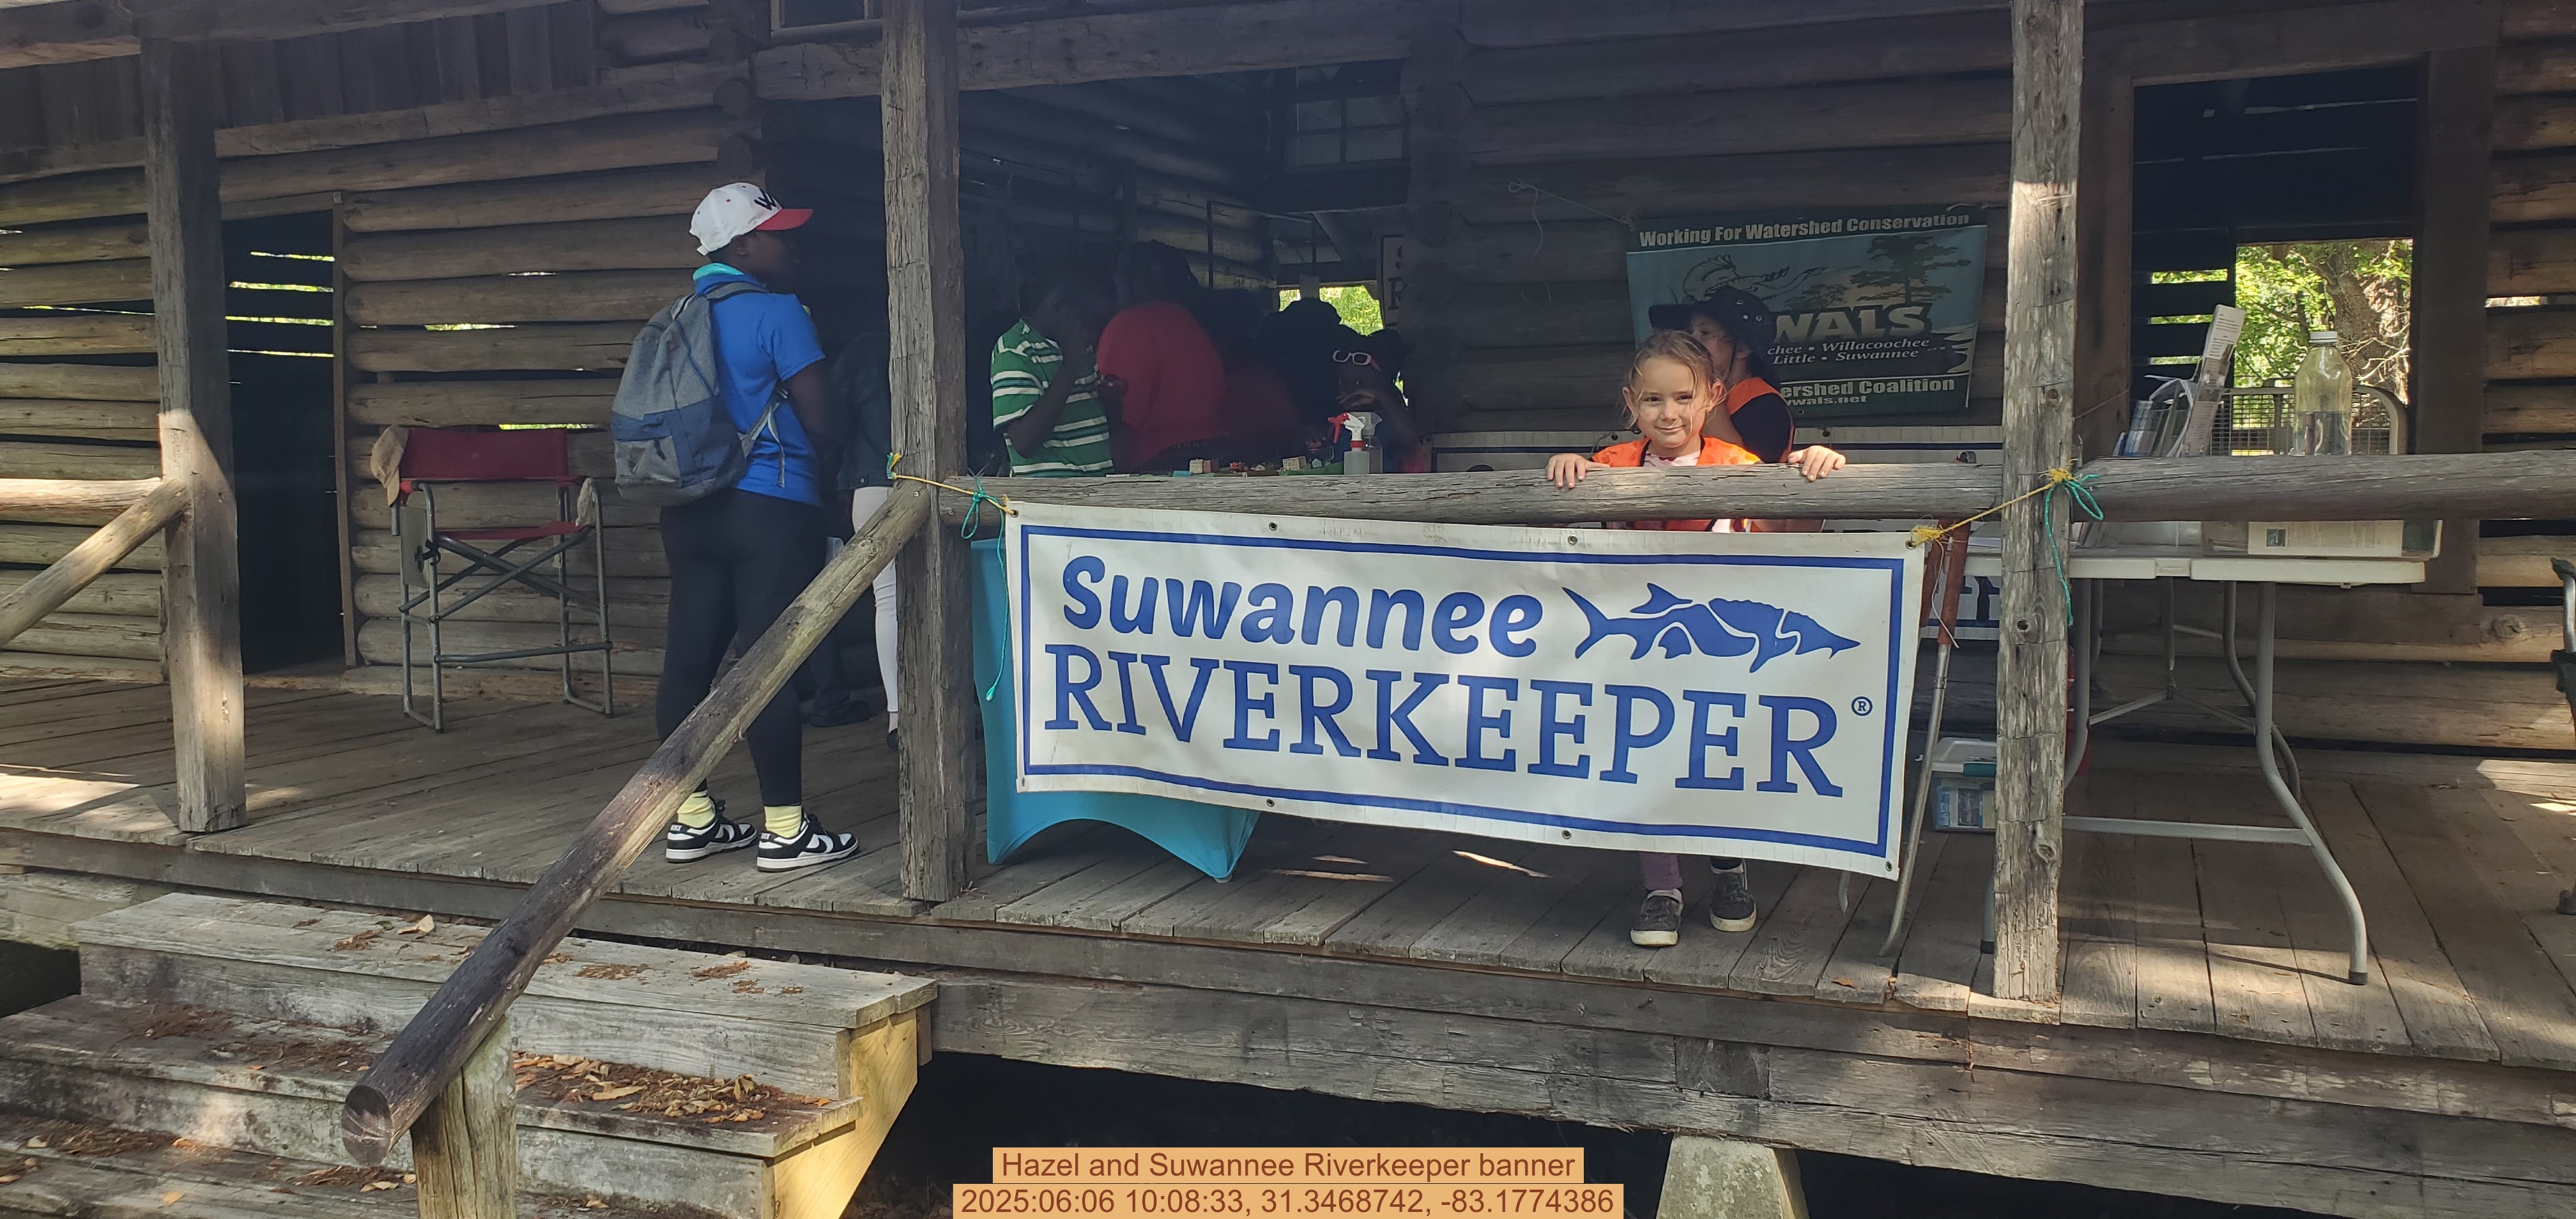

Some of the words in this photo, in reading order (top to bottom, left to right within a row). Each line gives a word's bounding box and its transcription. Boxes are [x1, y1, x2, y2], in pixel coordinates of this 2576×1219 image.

[1639, 229, 1712, 247] Working
[1715, 226, 1743, 241] For
[1745, 219, 1843, 240] Watershed
[1846, 214, 1970, 232] Conservation
[1768, 345, 1802, 355] chee
[1822, 339, 1929, 351] Willacoochee
[1773, 353, 1815, 364] Little
[1836, 350, 1919, 362] Suwannee
[1781, 381, 1853, 398] ershed
[1859, 377, 1954, 394] Coalition
[1786, 395, 1867, 406] wals.net
[1063, 556, 1543, 658] Suwannee
